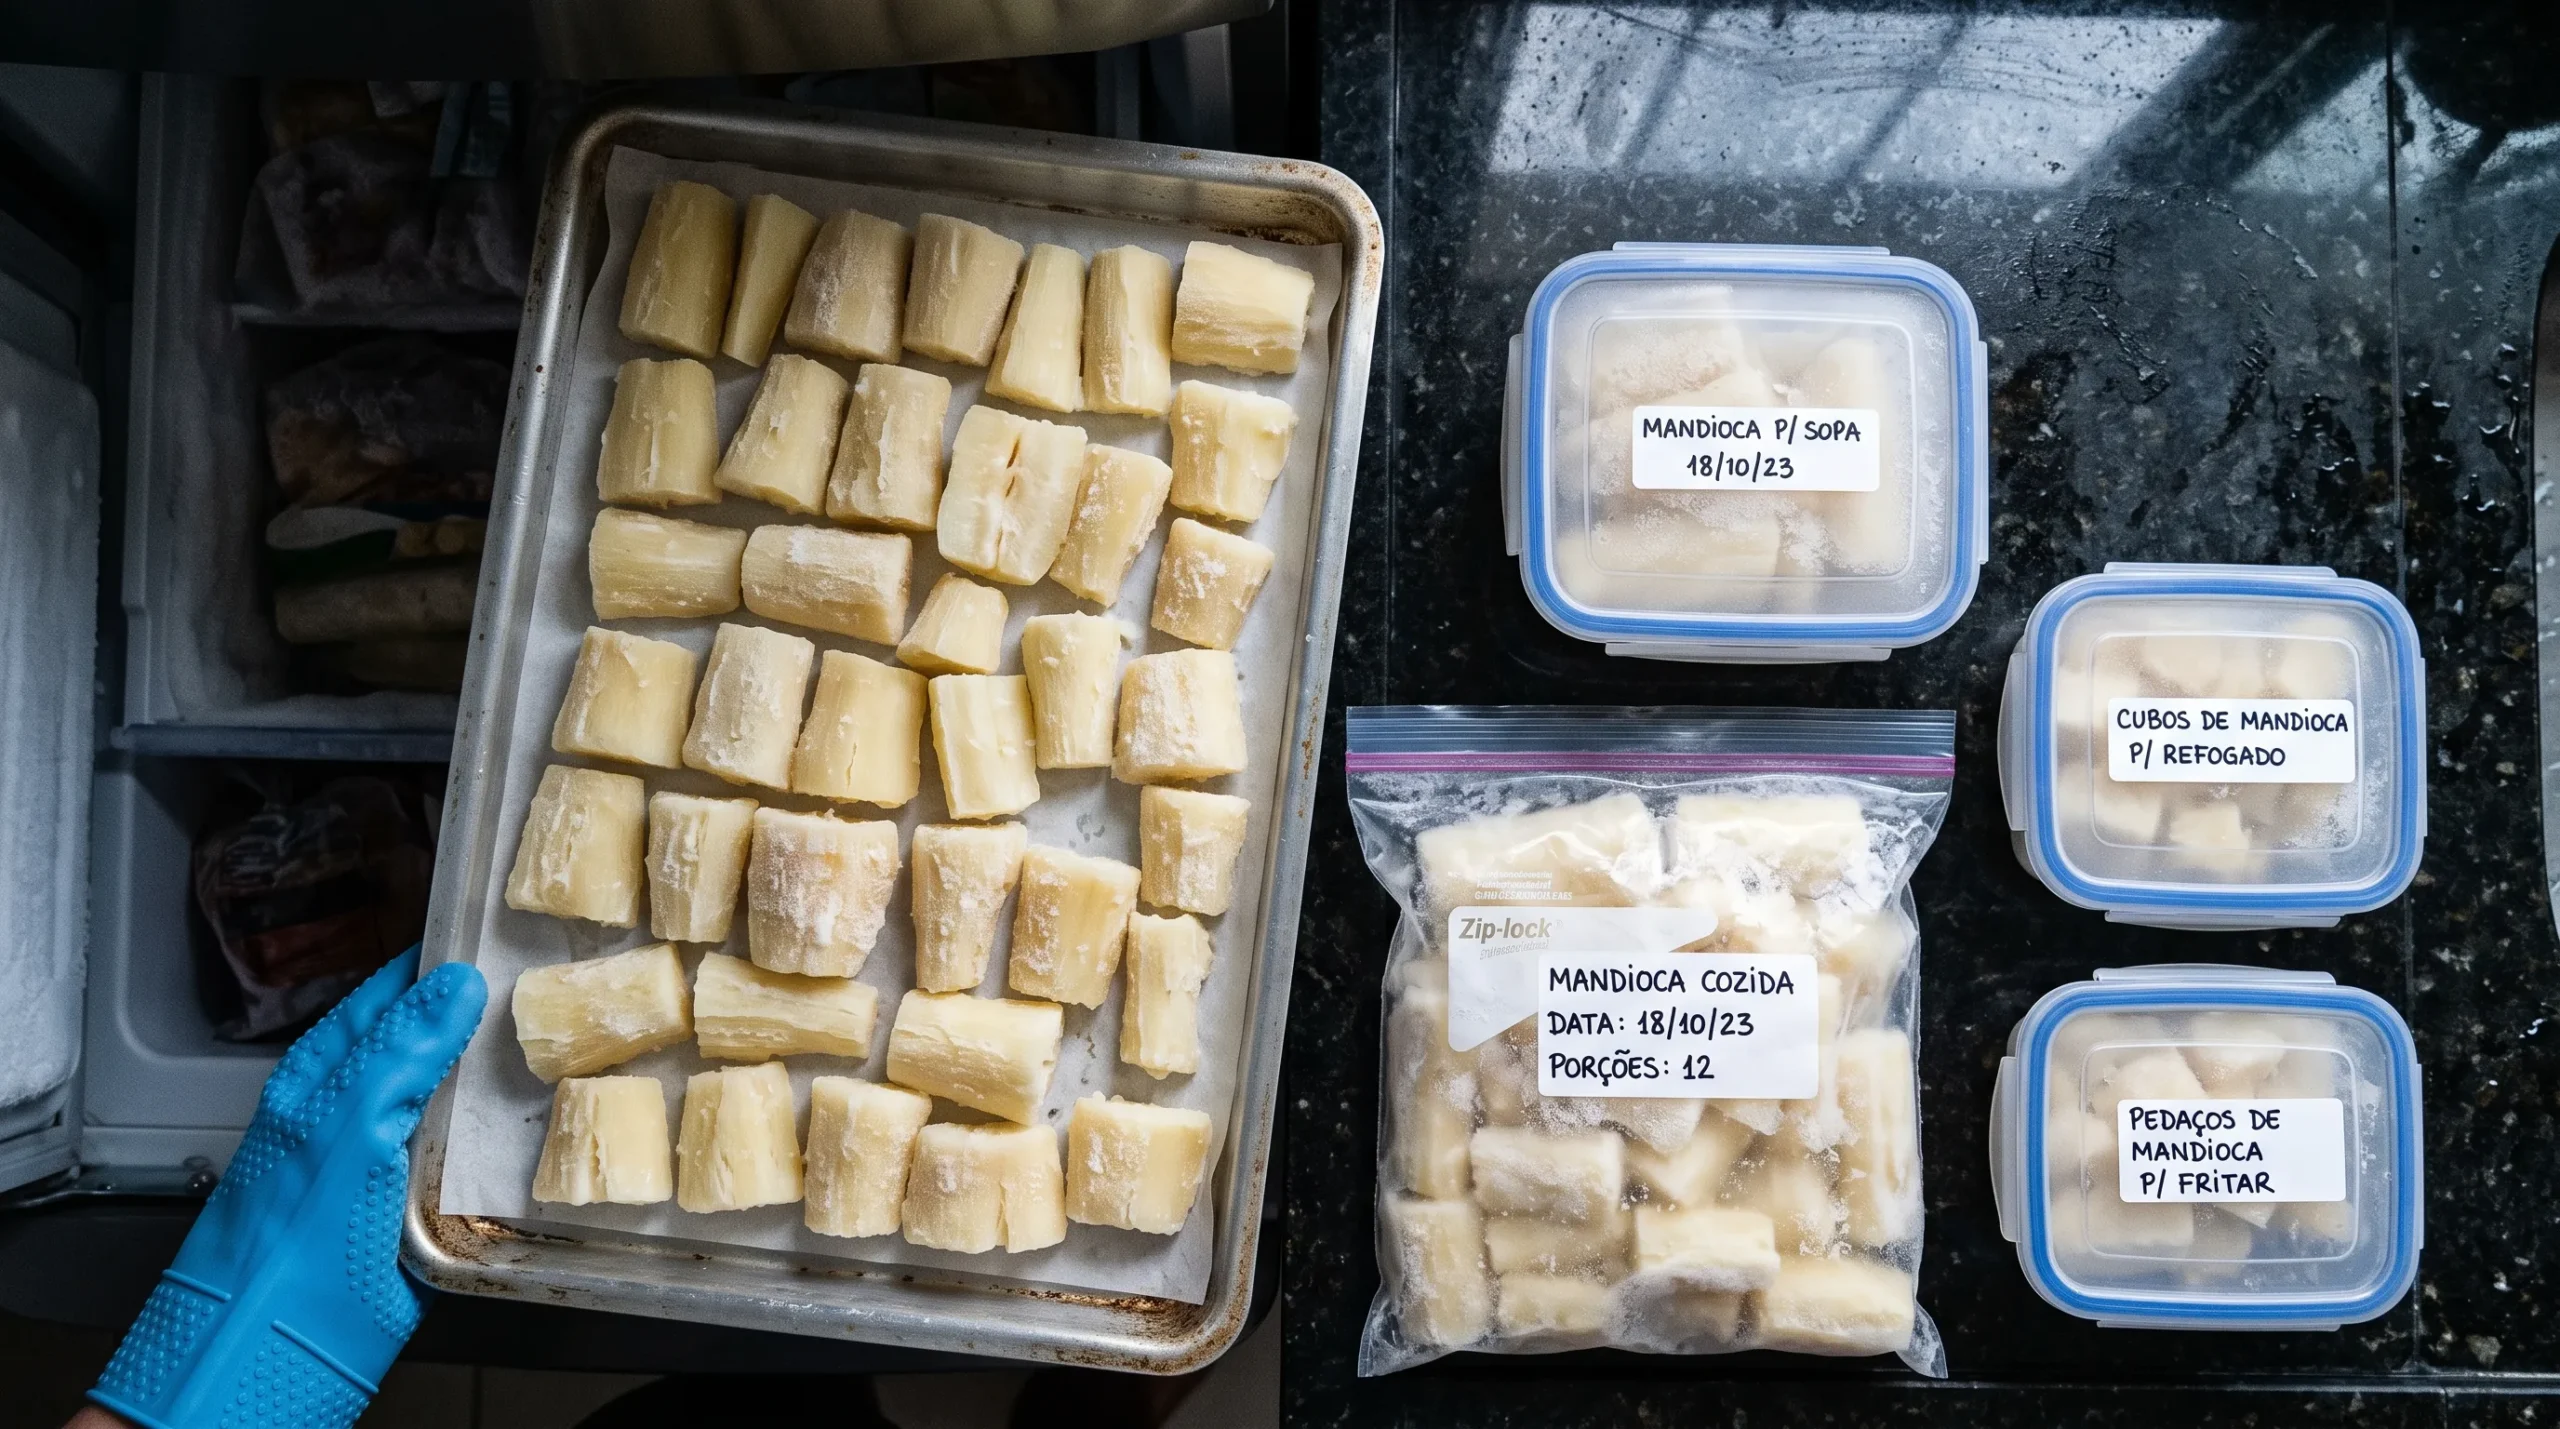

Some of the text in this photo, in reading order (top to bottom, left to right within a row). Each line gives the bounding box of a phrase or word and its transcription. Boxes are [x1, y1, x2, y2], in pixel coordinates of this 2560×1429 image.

[1643, 414, 1861, 445] MANDIOCA P/ SOPA
[1686, 451, 1794, 483] 18/10/23
[2116, 707, 2349, 733] CUBOS DE MANDIOCA
[2129, 739, 2286, 770] P/ REFOGADO
[1458, 917, 1552, 944] Zip-lock
[1549, 963, 1794, 995] MANDIOCA COZIDA
[1546, 1006, 1755, 1041] DATA: 18/10/23
[1548, 1048, 1715, 1087] PORÇÕES: 12
[2128, 1106, 2281, 1138] PEDAÇOS DE
[2132, 1138, 2264, 1163] MANDIOCA
[2139, 1168, 2276, 1200] P/ FRITAR
